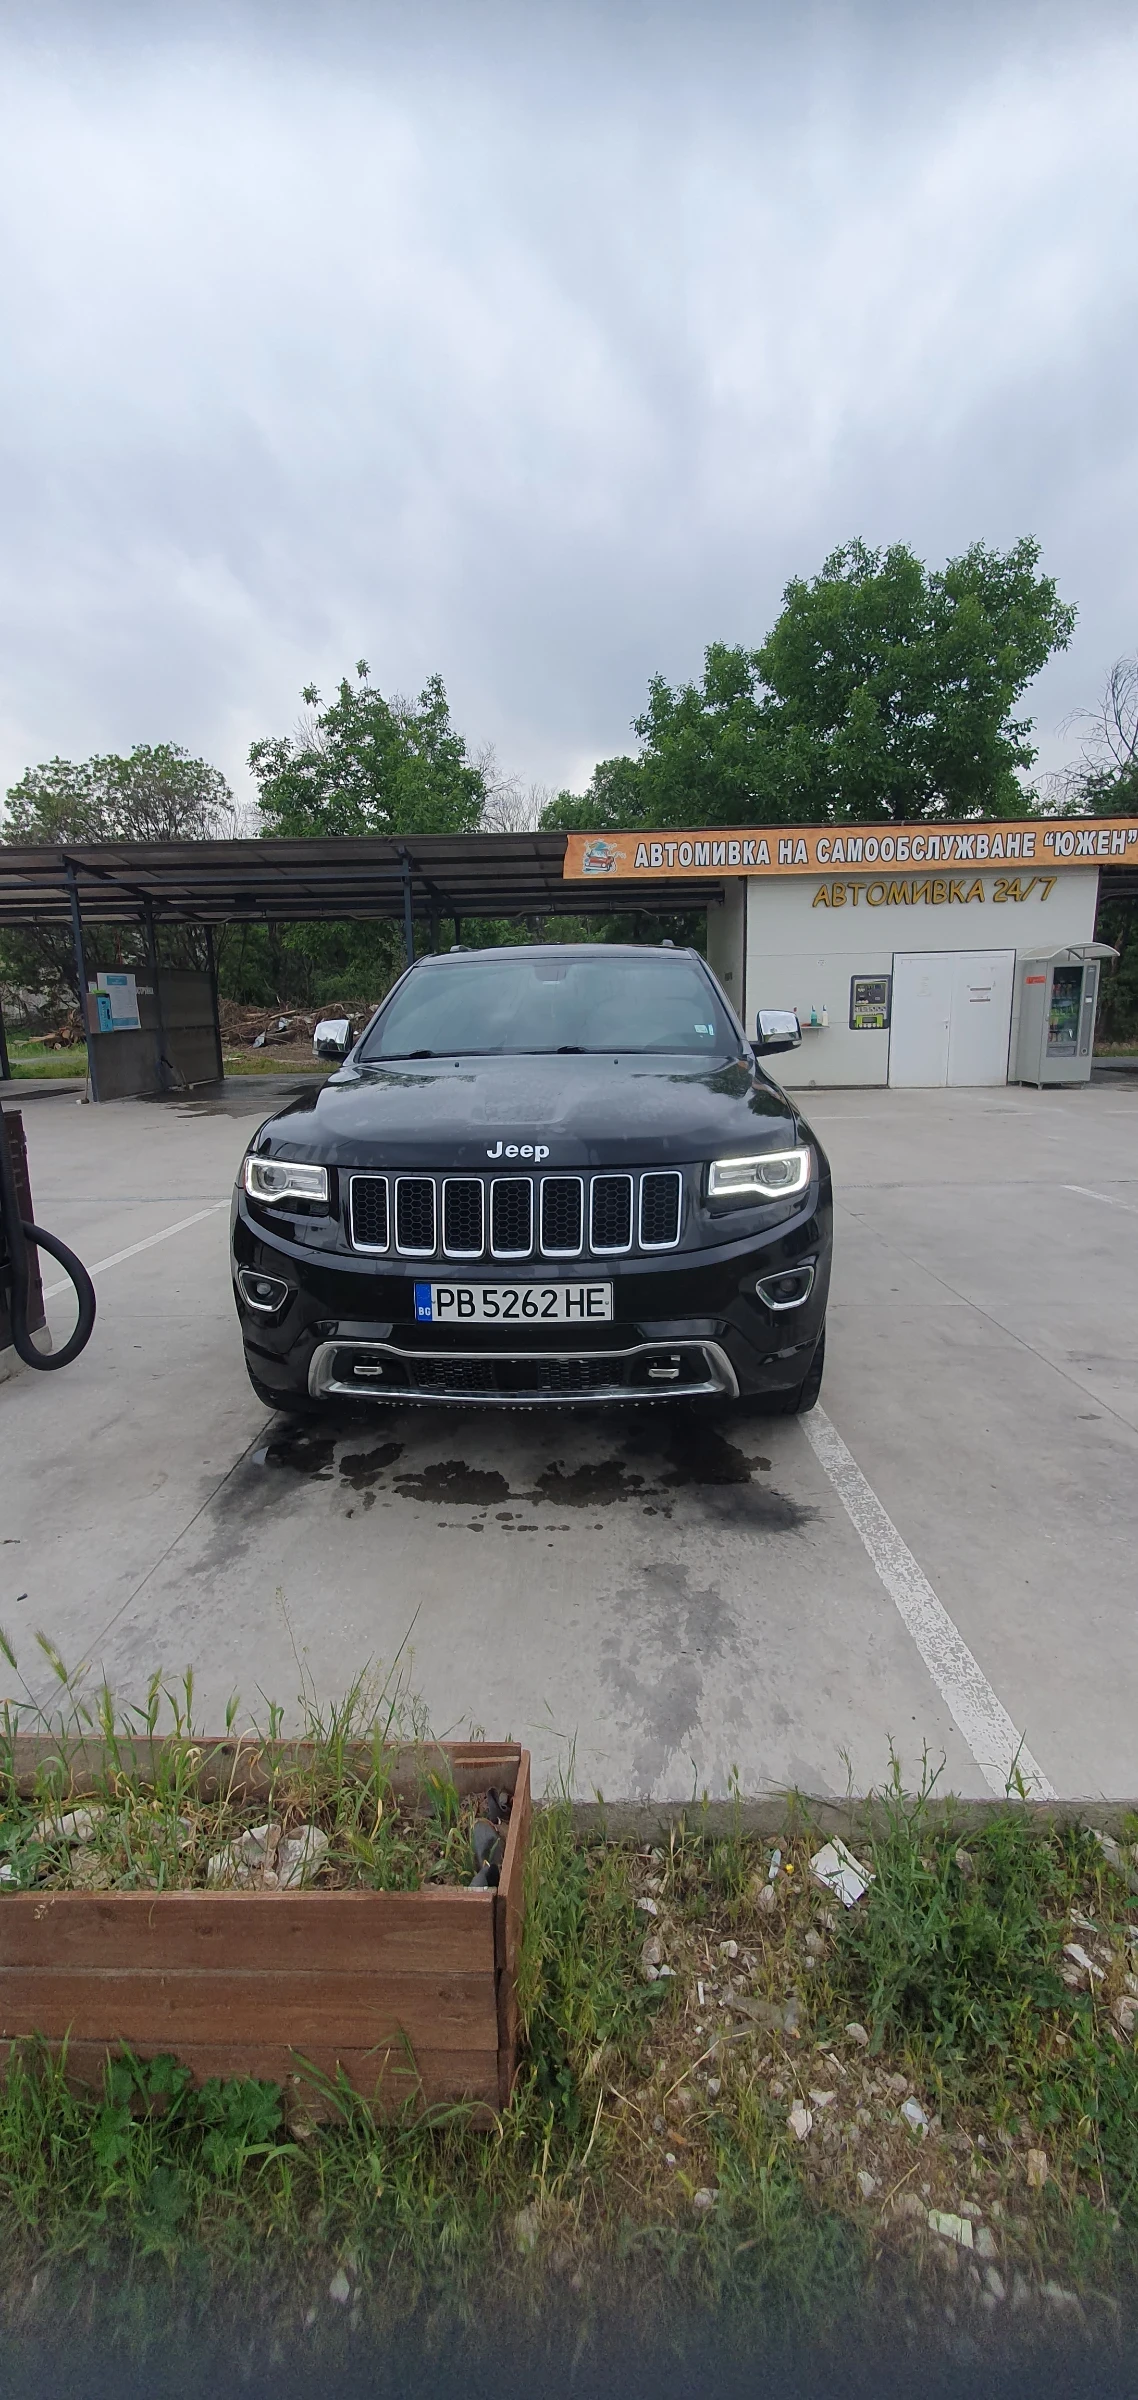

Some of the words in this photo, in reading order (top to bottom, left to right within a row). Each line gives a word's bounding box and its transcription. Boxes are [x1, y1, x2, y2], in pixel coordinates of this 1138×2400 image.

[634, 840, 771, 868] АВТОМИВКА
[778, 839, 808, 864] НА
[816, 832, 1036, 863] САМООБСЛУЖВАНЕ
[812, 878, 985, 908] АВТОМИВКА
[993, 876, 1057, 902] 24/7
[486, 1141, 550, 1162] Jeep
[418, 1307, 431, 1316] BG
[436, 1289, 475, 1317] PB
[482, 1289, 558, 1318] 5262
[565, 1288, 605, 1317] HE
